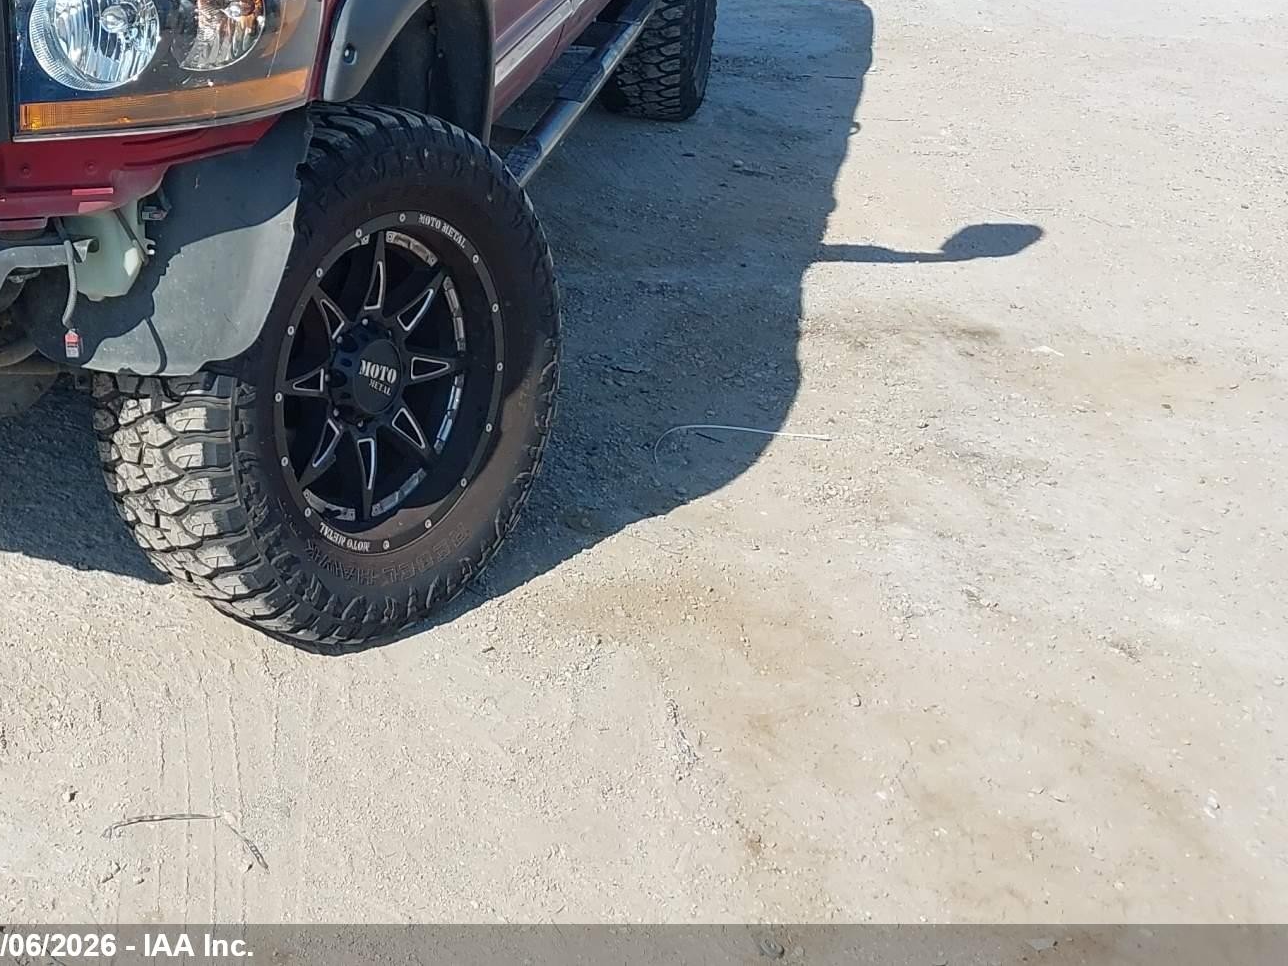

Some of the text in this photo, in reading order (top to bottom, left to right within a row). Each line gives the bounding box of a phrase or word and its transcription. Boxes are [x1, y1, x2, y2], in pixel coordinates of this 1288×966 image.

[418, 213, 467, 249] MOTO METAL
[358, 359, 398, 385] MOTO
[368, 378, 392, 396] METAL
[319, 521, 371, 553] MOTO METAL
